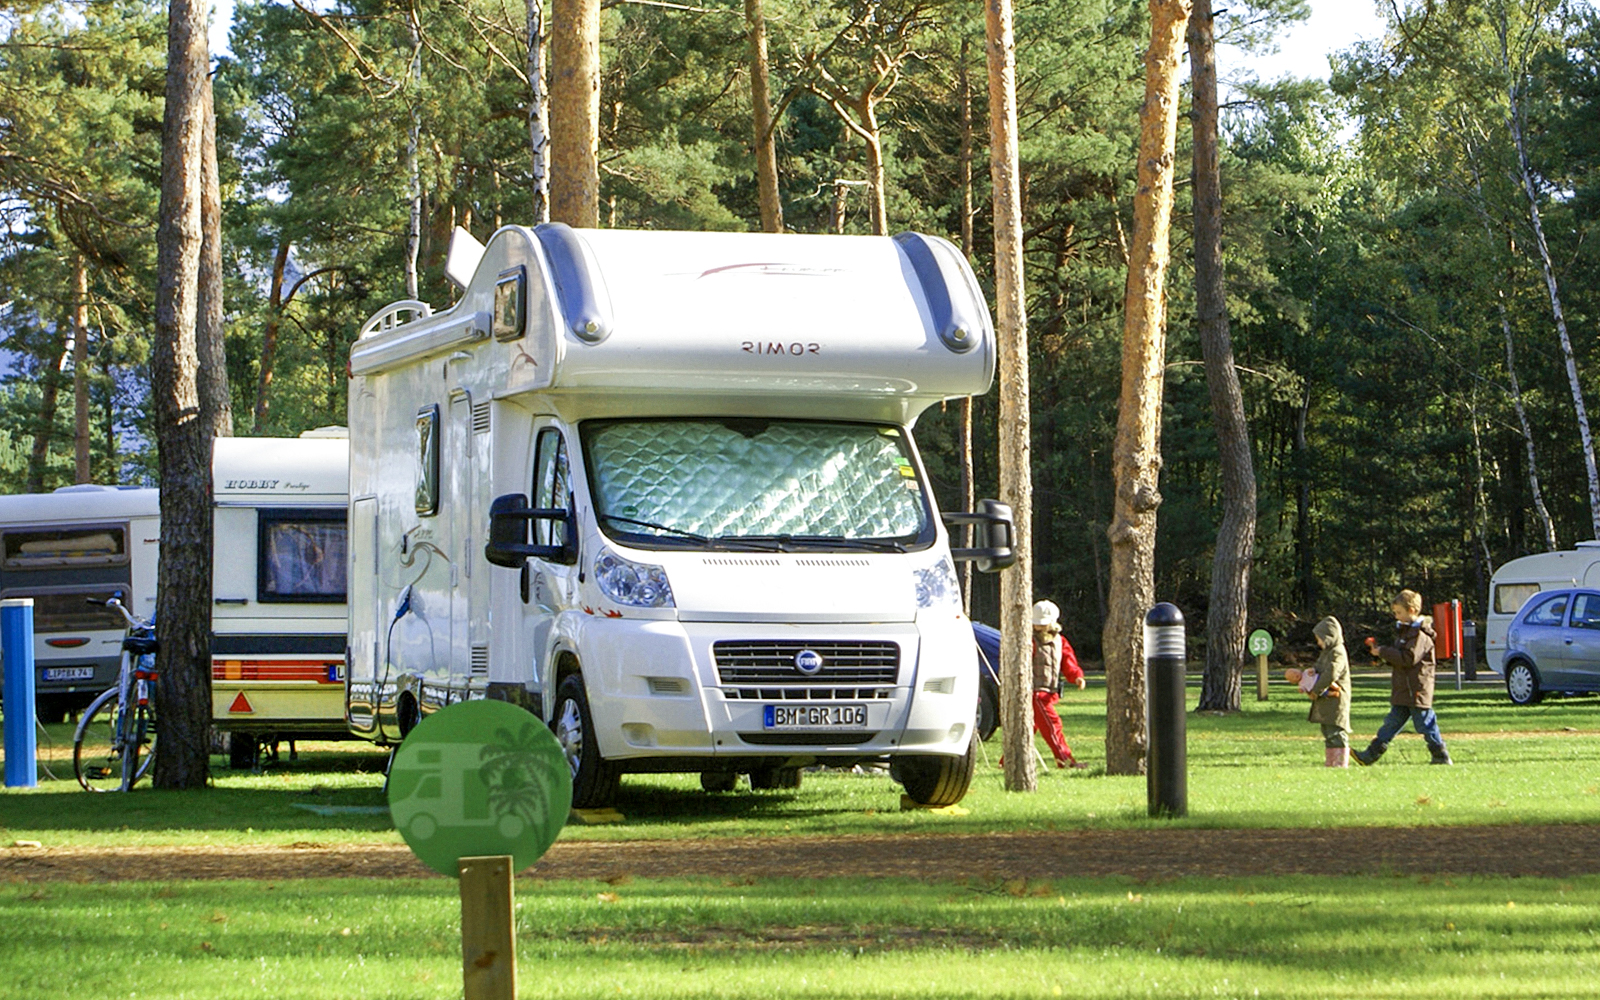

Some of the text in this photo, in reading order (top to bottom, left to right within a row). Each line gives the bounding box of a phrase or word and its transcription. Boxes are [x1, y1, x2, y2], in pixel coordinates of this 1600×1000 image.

[741, 341, 820, 356] RIMOR
[224, 479, 279, 489] HOBBY
[1254, 637, 1267, 651] 53
[775, 708, 865, 725] BM GR 106
